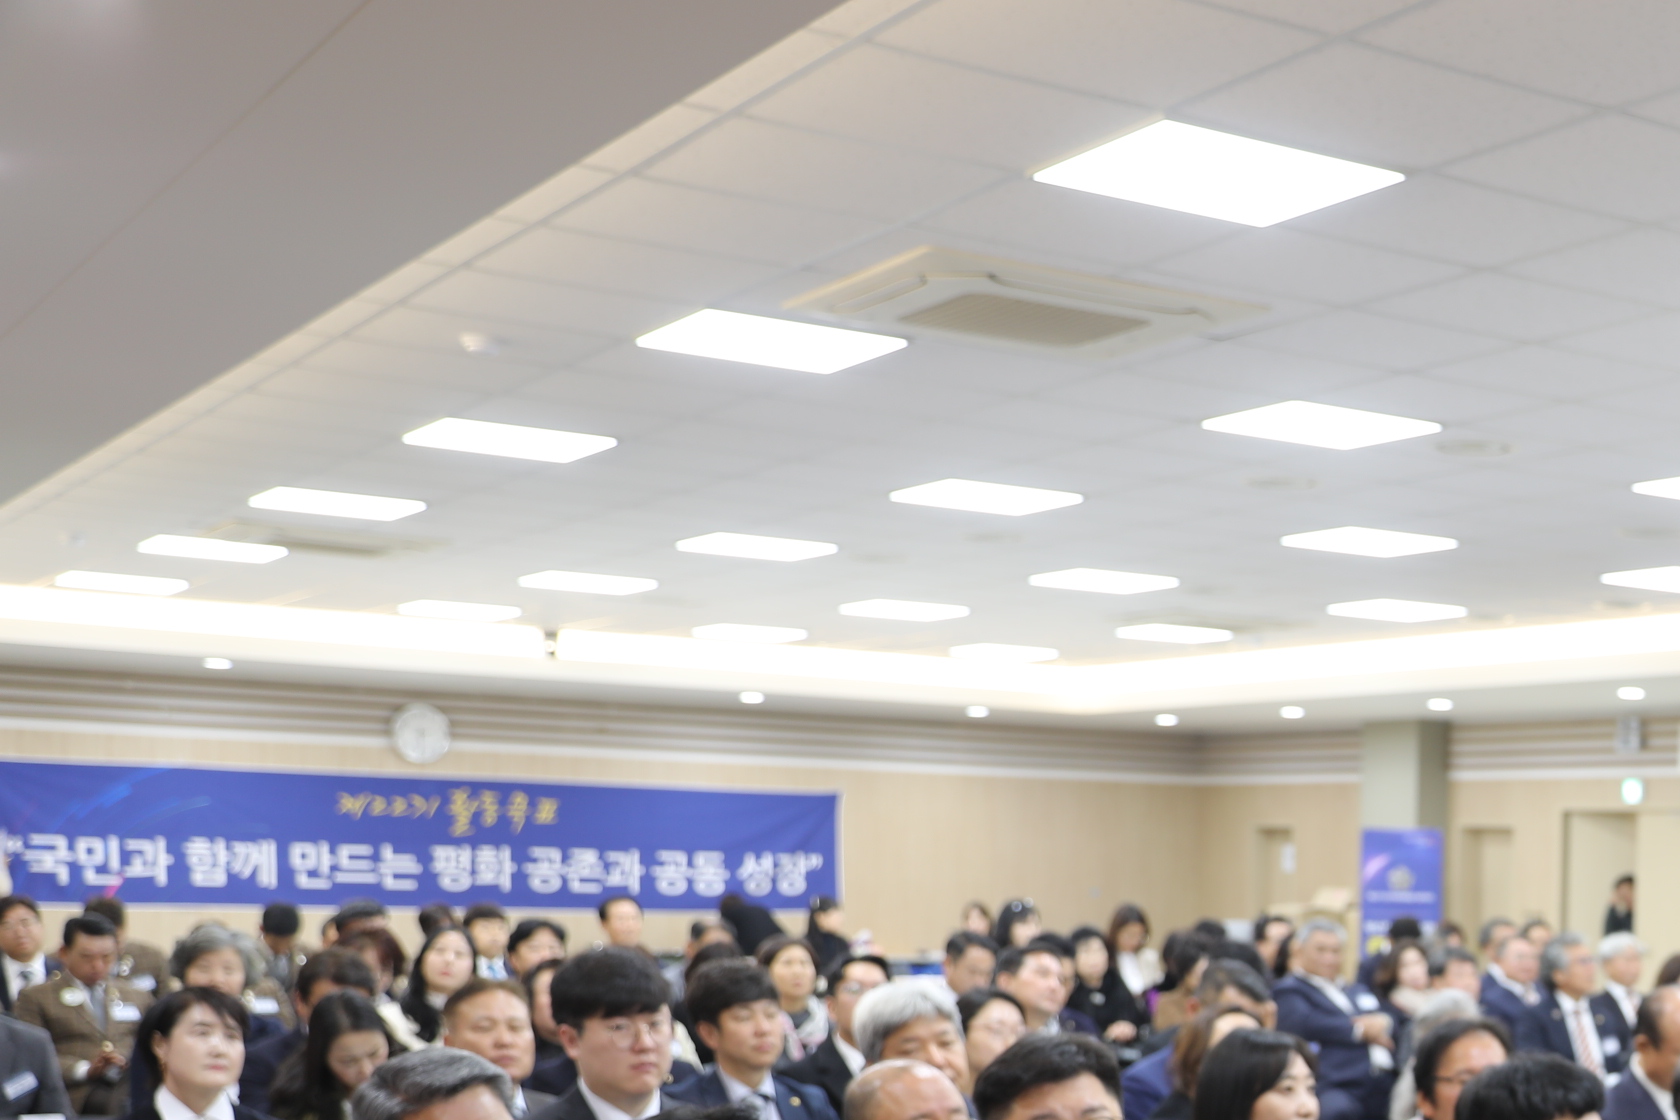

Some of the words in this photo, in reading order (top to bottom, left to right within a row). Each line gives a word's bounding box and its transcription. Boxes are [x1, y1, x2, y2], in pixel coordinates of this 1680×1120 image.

[182, 836, 278, 889] 함께
[288, 840, 423, 891] 만드는
[429, 843, 518, 893] 평화
[521, 846, 646, 896] 공존과
[651, 849, 730, 897] 공동
